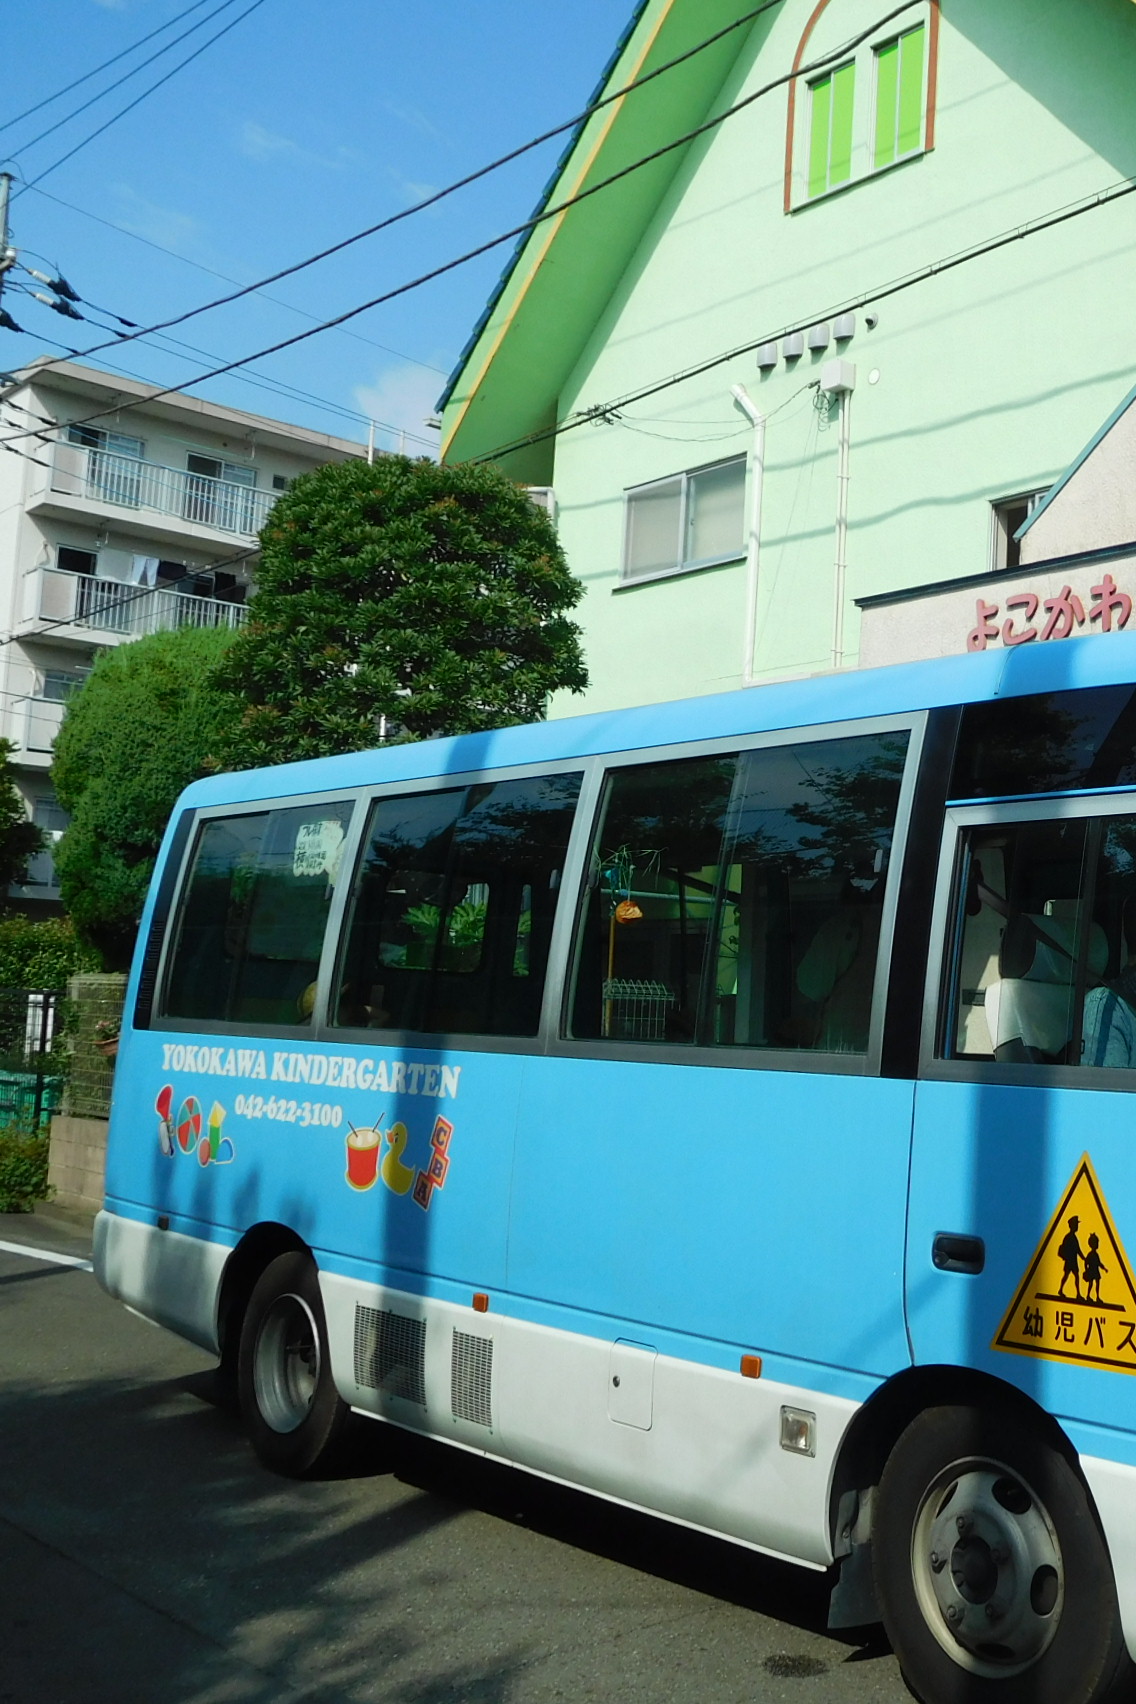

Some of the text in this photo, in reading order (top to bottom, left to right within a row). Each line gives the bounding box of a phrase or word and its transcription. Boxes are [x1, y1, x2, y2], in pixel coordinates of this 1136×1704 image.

[162, 1044, 461, 1098] YOKOKAWA KINDERGARTEN
[234, 1093, 343, 1128] 042-622-3100
